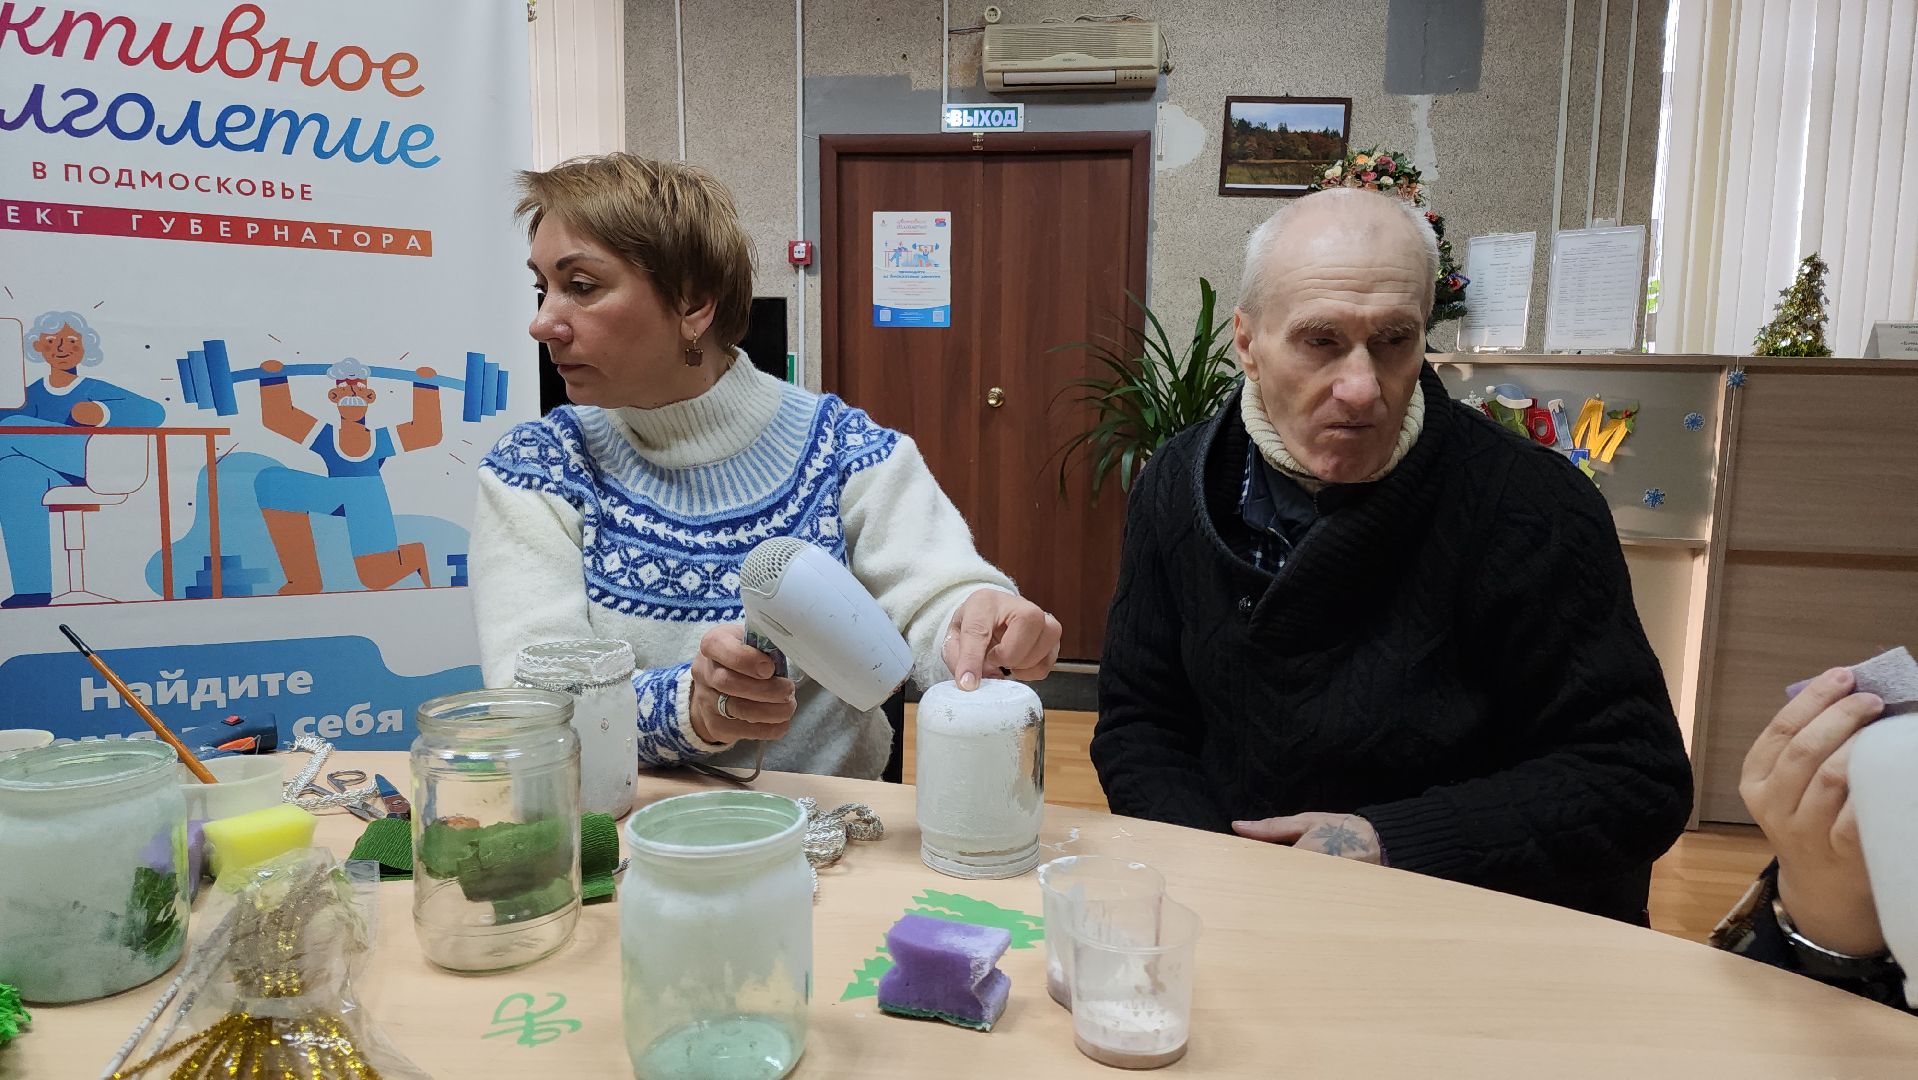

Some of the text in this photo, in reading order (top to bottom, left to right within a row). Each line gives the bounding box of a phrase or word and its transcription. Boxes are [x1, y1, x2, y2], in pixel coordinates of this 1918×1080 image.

[0, 2, 425, 97] ктивное
[950, 109, 1017, 128] ВЫХОД
[32, 161, 314, 202] В ПОДМОСКОВЬЕ
[6, 205, 423, 252] ЕКТ ГУБЕРНАТОРА
[80, 667, 315, 712] Найдите
[292, 702, 403, 742] себя
